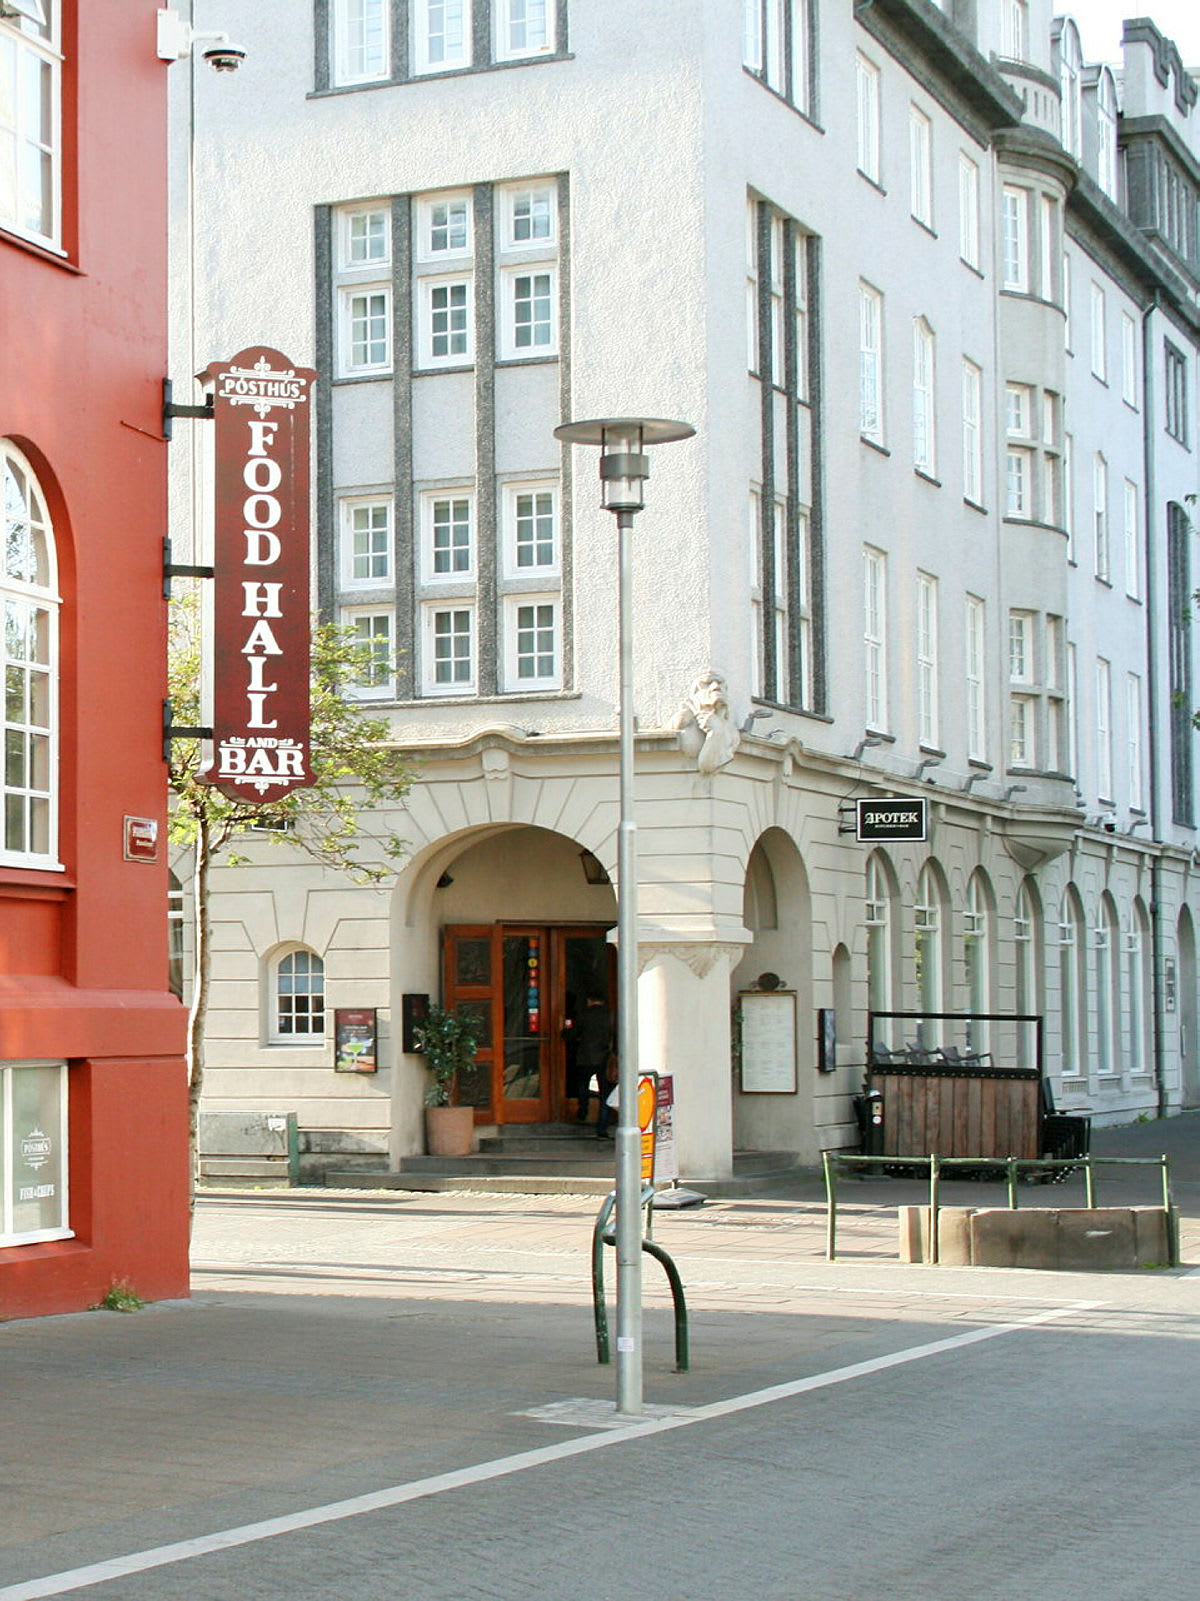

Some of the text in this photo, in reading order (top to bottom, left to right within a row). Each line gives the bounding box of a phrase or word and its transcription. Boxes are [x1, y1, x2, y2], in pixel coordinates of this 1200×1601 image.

[224, 377, 301, 398] PÓSTHÚS
[241, 421, 284, 729] FOOD HALL
[247, 737, 278, 748] AND
[218, 748, 306, 775] BAR
